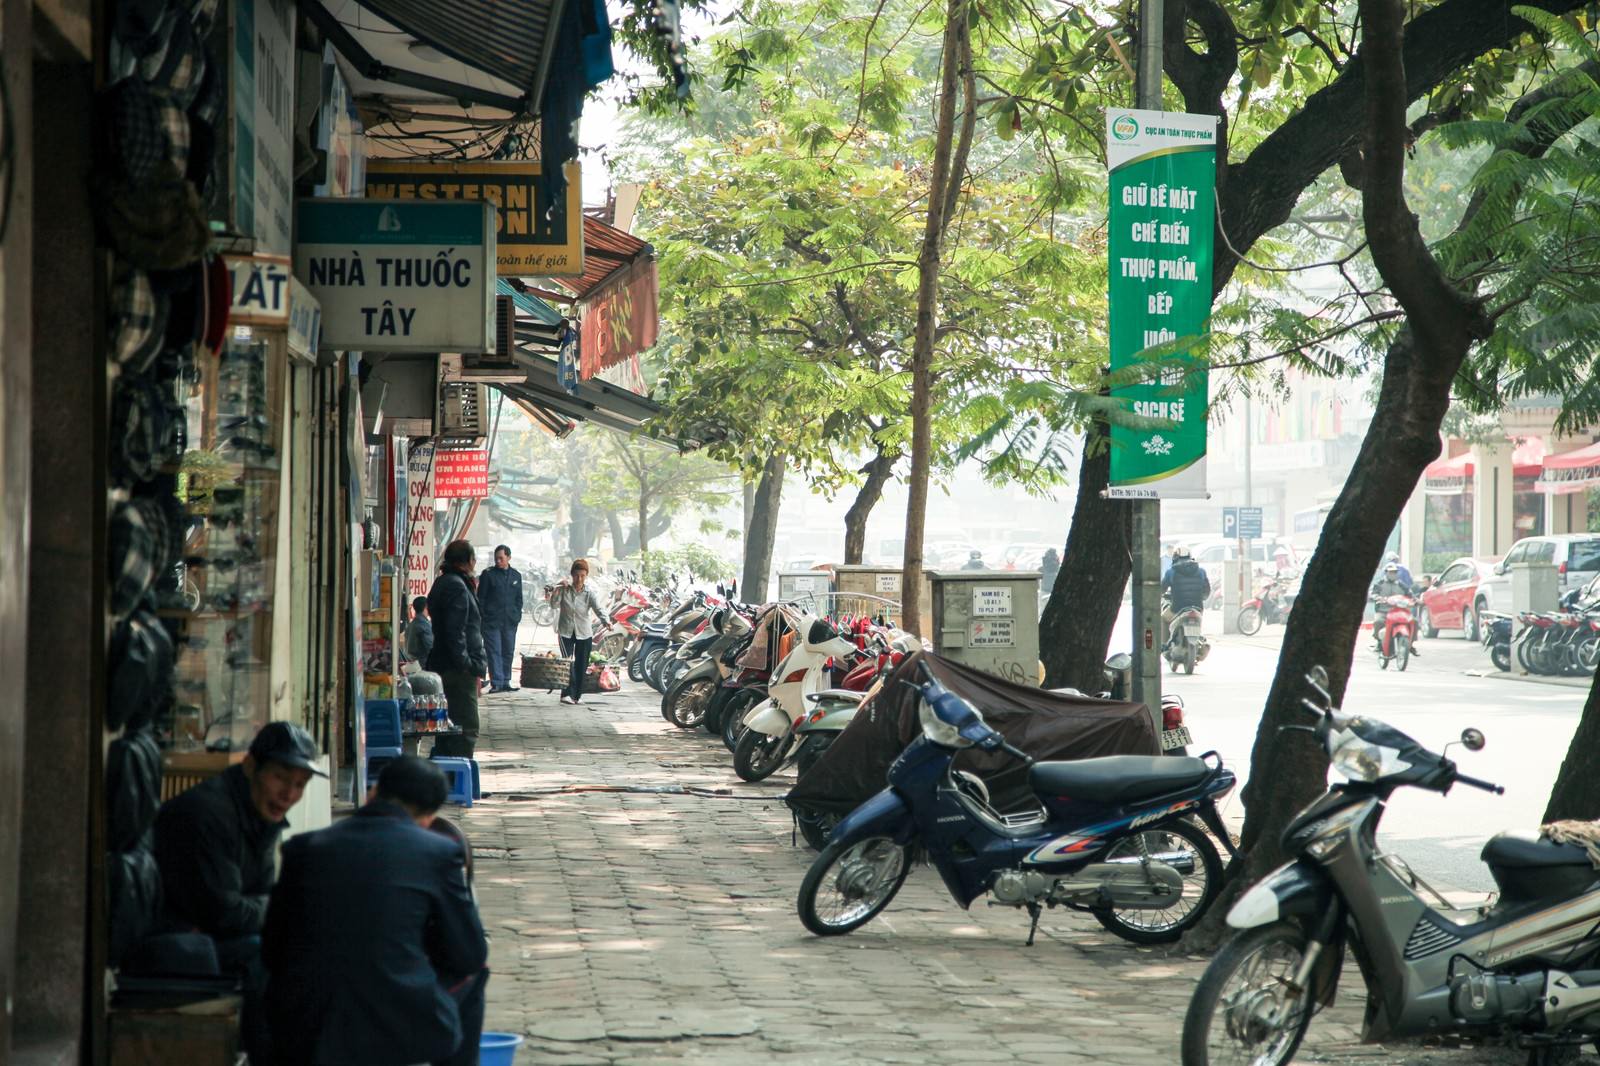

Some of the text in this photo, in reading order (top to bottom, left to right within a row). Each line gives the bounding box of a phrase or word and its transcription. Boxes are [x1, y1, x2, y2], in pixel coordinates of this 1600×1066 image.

[367, 183, 528, 208] WESTERN
[1122, 182, 1197, 214] GIỮ BỀ MẶT
[1132, 219, 1190, 245] CHẾ BIẾN
[309, 248, 471, 288] NHÀ THUỐC
[525, 250, 543, 266] thế
[546, 253, 568, 268] giới
[1120, 255, 1198, 283] THỰC PHẨM,
[1148, 291, 1173, 315] BẾP
[361, 300, 417, 337] TÂY
[1169, 398, 1185, 422] SẼ
[456, 464, 486, 472] RANG
[410, 480, 431, 498] CƠM
[1224, 514, 1235, 533] P
[411, 526, 427, 546] MỲ
[408, 551, 428, 571] XÀO
[408, 573, 428, 595] PHỞ
[1164, 737, 1189, 748] 7511
[936, 815, 966, 823] HONDA
[1380, 895, 1415, 905] HONDA
